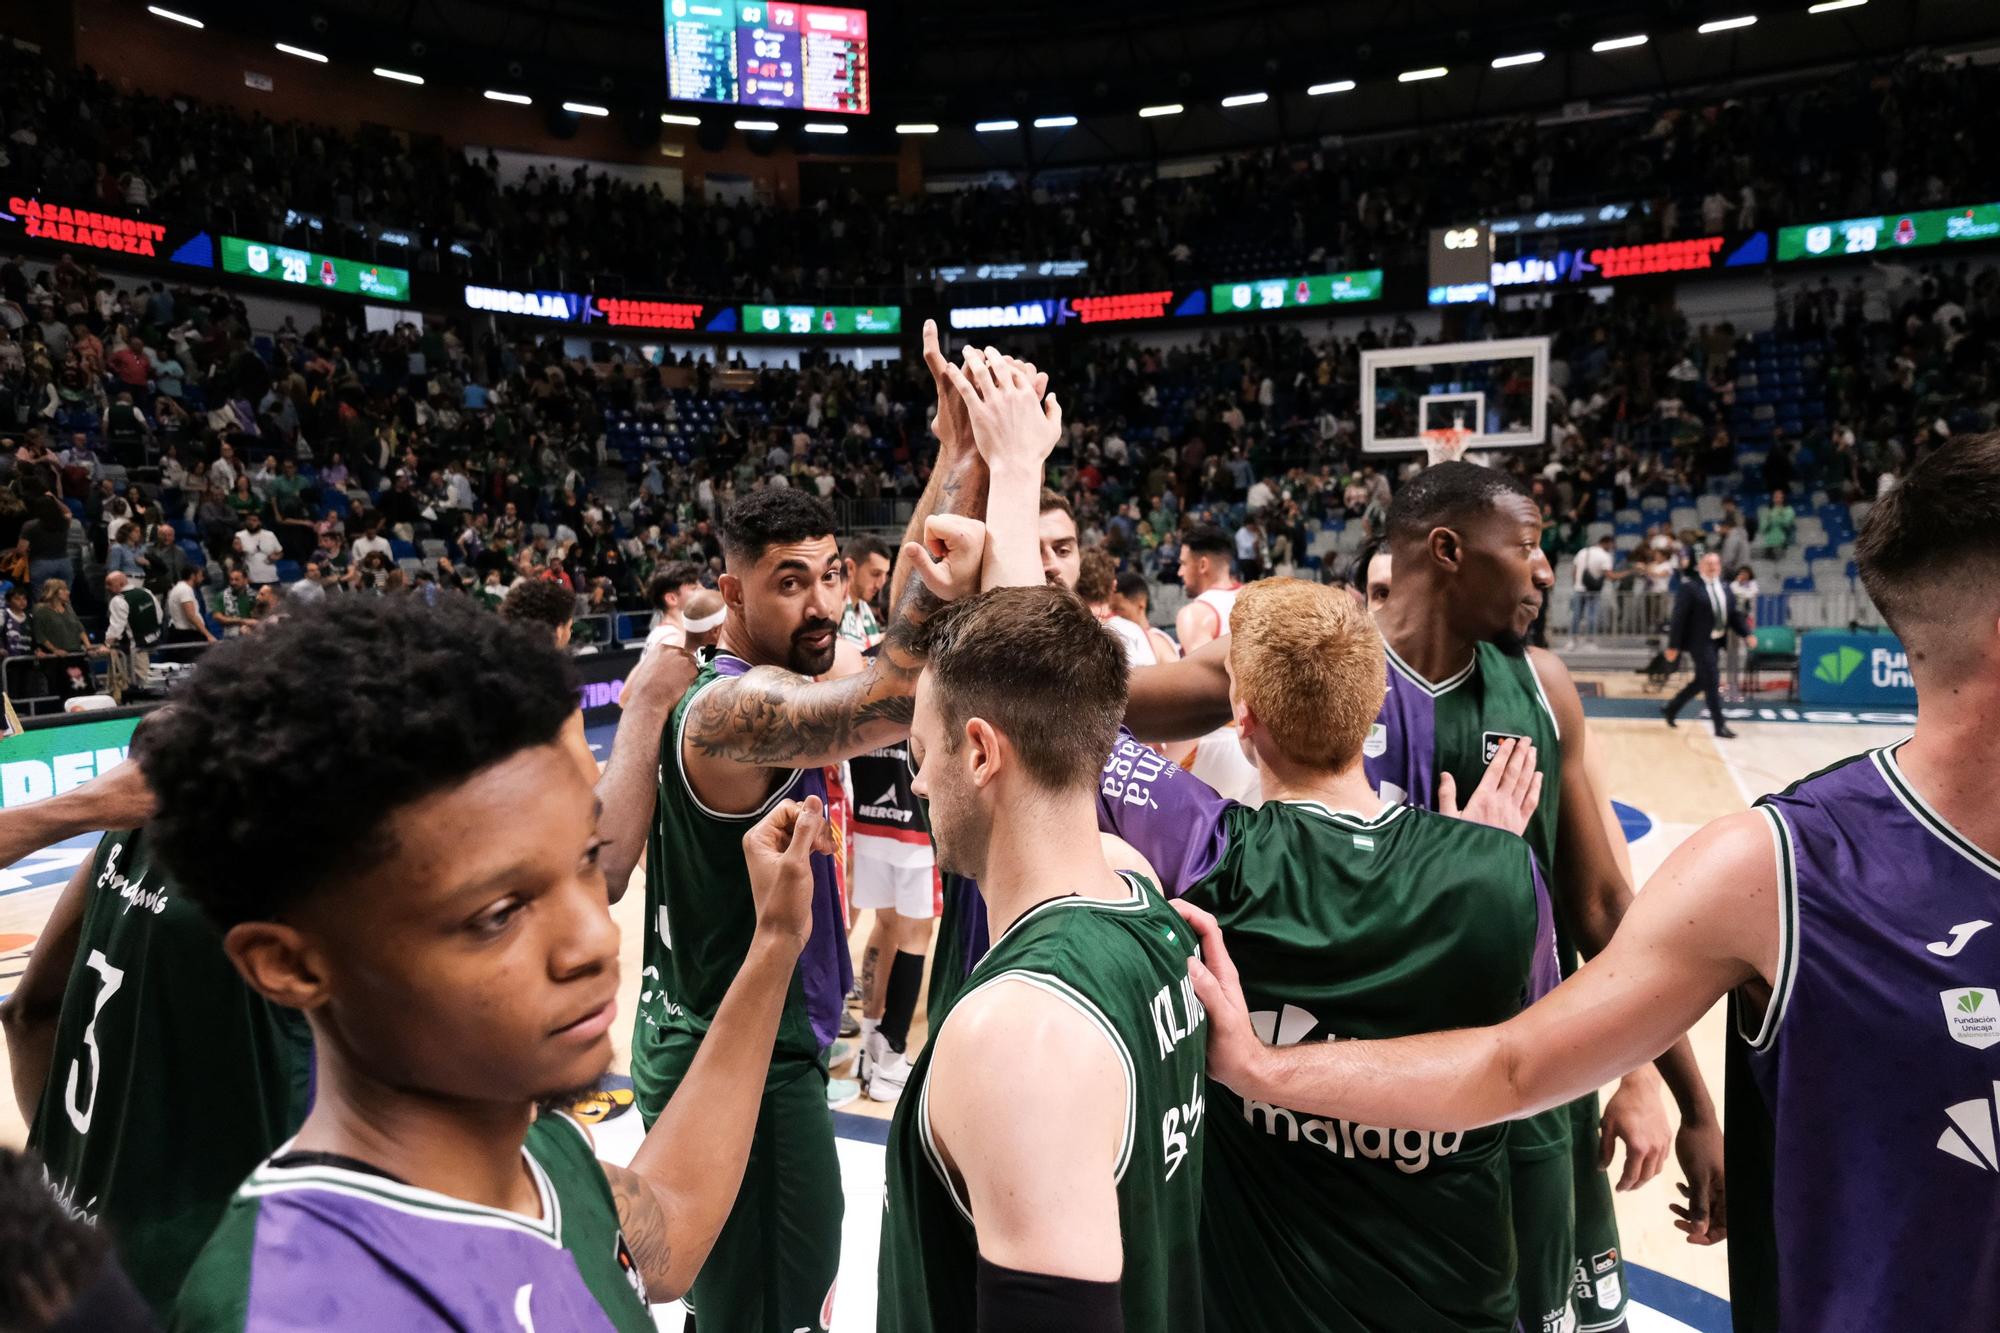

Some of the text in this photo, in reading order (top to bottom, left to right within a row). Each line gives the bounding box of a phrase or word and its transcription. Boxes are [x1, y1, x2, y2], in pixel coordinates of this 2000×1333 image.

[775, 9, 794, 26] 72
[9, 197, 166, 241] CASADEMONT
[25, 217, 155, 256] ZARAGOZA
[1590, 236, 1724, 265] CASADEMONT
[282, 257, 307, 283] 29
[1601, 253, 1711, 278] ZARAGOZA
[465, 285, 569, 319] UNICAJA
[598, 298, 703, 318] CASADEMONT
[1071, 291, 1173, 311] CASADEMONT
[608, 311, 695, 330] ZARAGOZA
[950, 304, 1045, 328] UNICAJA
[1081, 304, 1164, 323] ZARAGOZA
[859, 804, 913, 823] MERCURY
[65, 949, 124, 1134] 3
